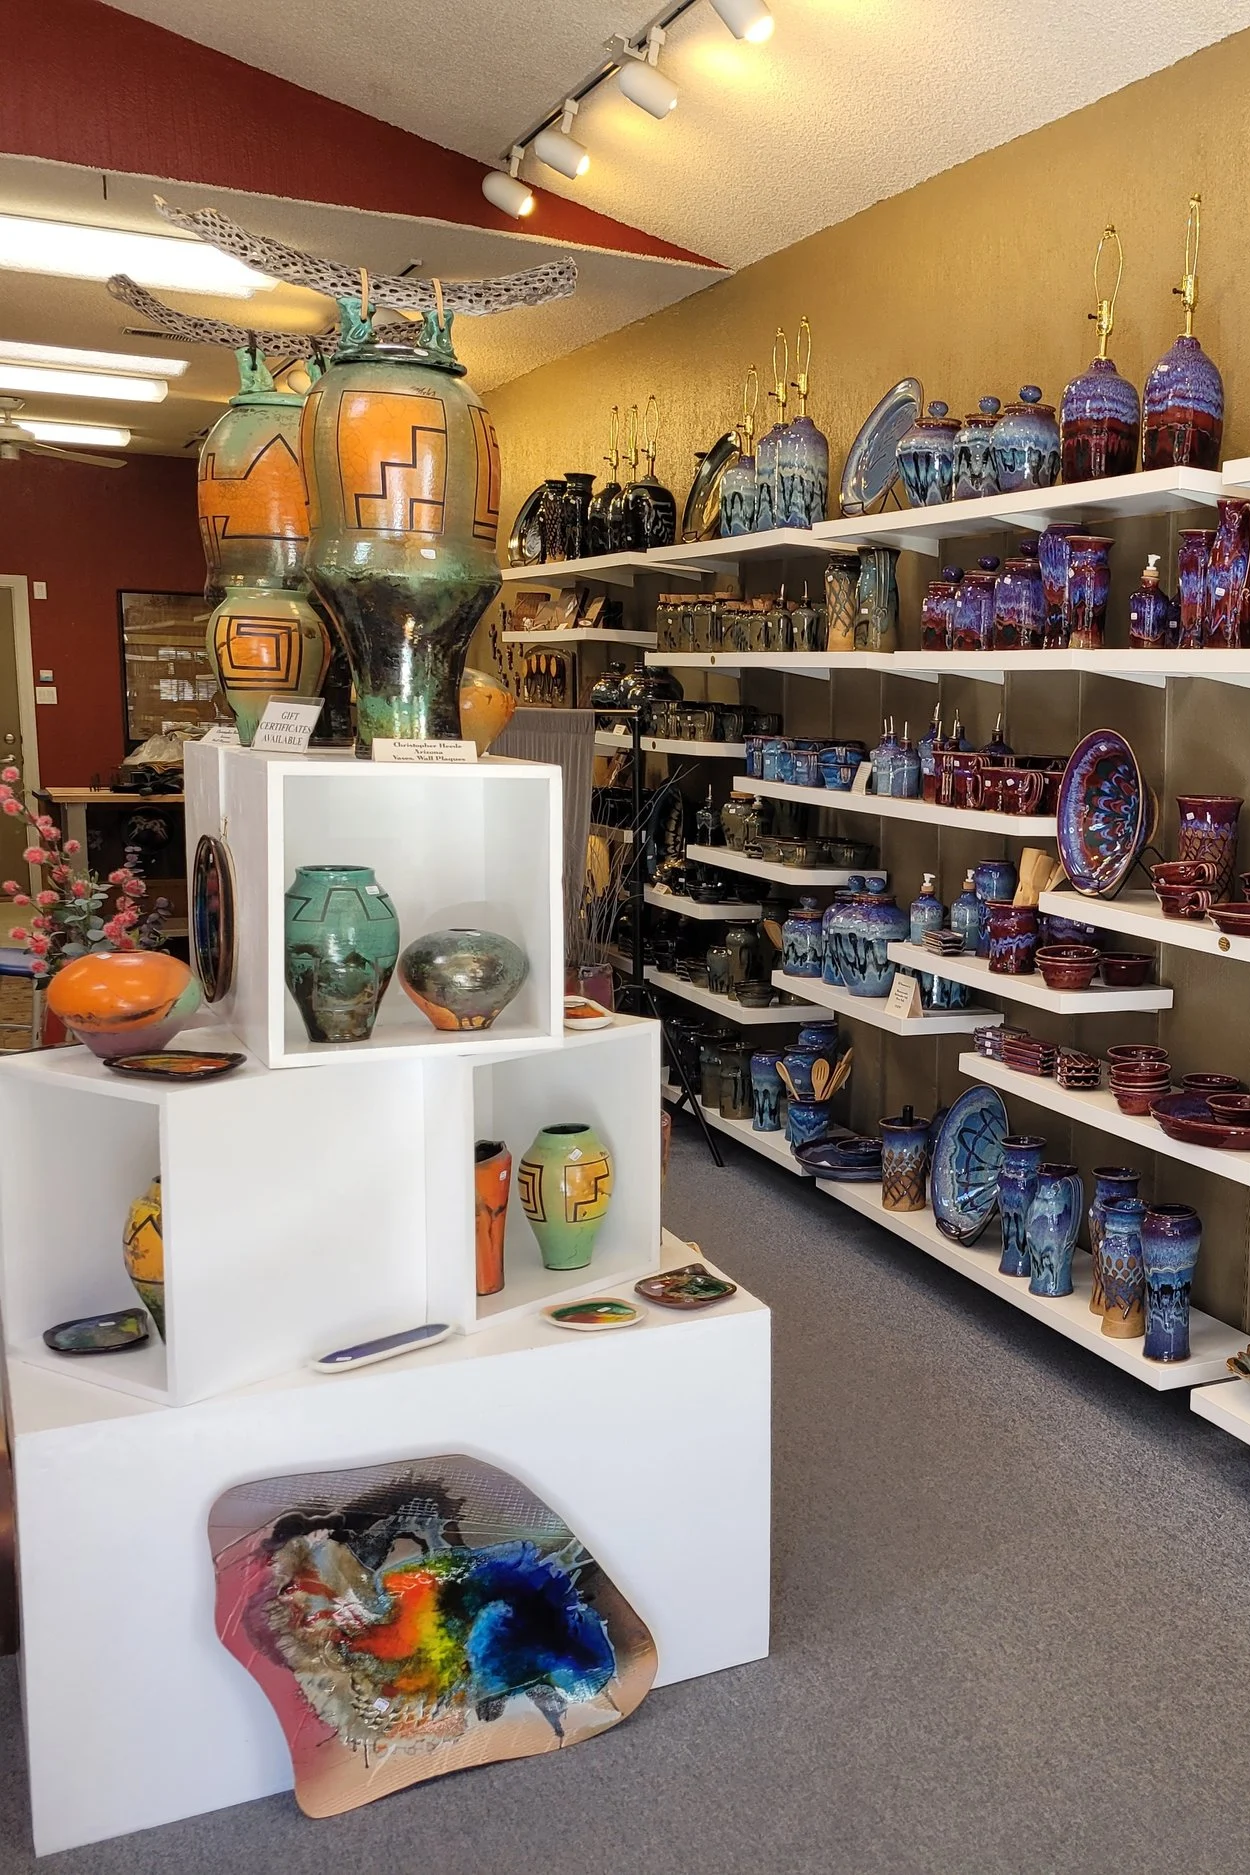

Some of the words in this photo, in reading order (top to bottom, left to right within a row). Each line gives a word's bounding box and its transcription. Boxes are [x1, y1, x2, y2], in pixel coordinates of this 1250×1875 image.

[281, 711, 300, 721] GIFT
[260, 721, 312, 734] CERTIFICATES
[262, 733, 304, 746] AVAILABLE
[393, 741, 437, 749] Christopher
